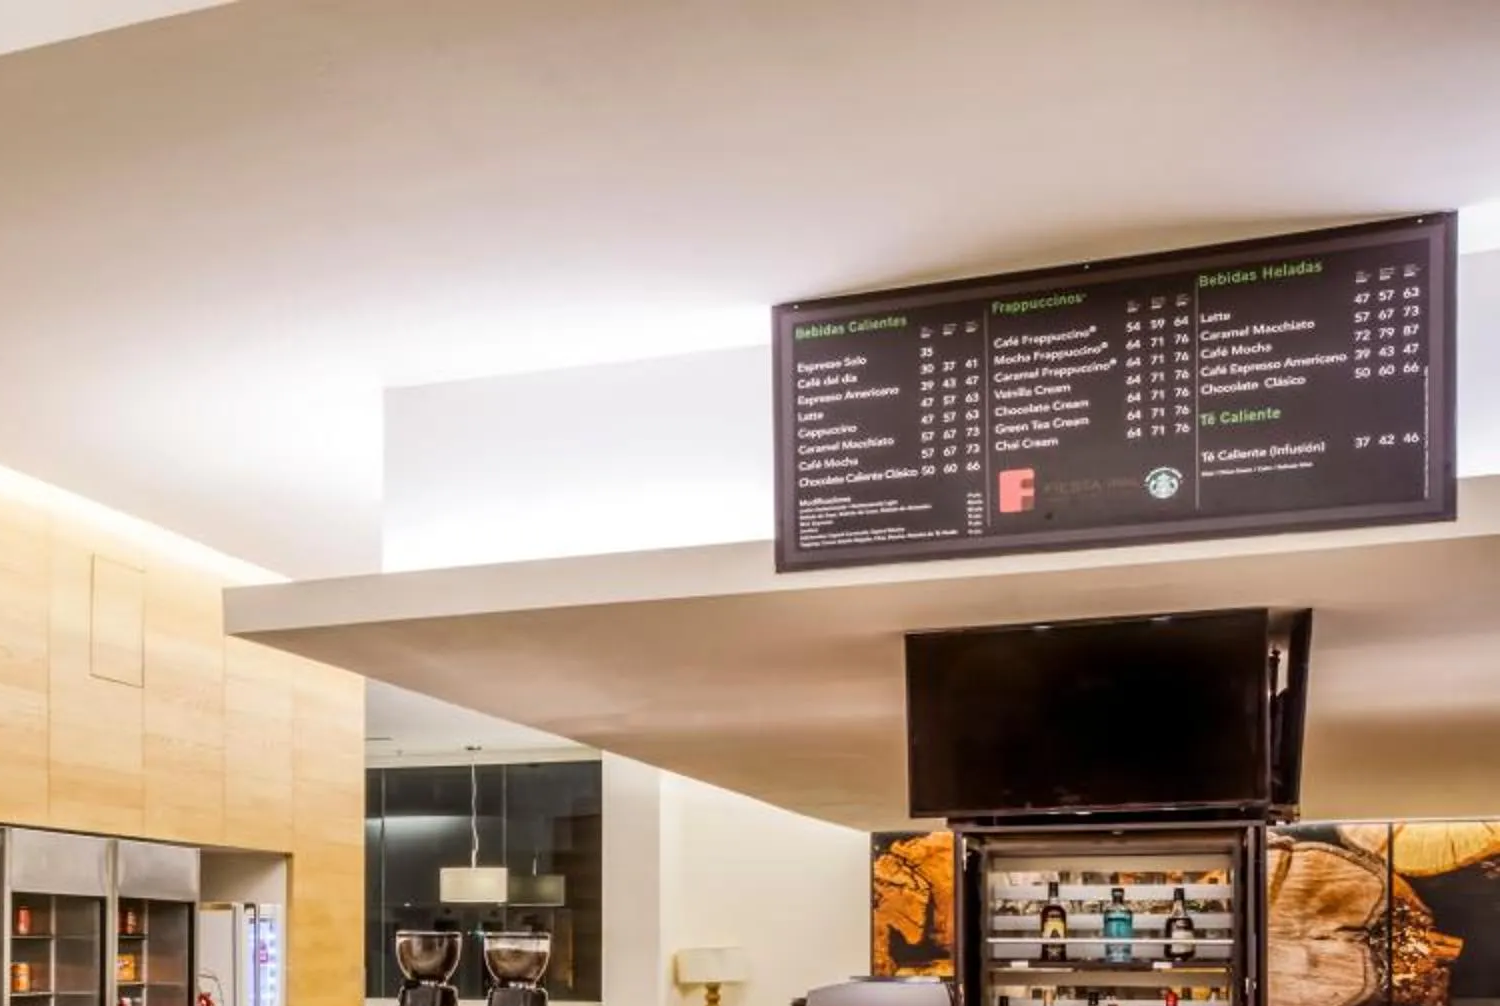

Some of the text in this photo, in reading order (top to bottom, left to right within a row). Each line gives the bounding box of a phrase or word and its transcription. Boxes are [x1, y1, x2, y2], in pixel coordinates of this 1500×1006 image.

[1199, 261, 1323, 288] Bebidas Heladas
[1201, 312, 1231, 323] Latte
[1354, 293, 1370, 303] 47
[1378, 290, 1394, 302] 57
[795, 323, 844, 339] Bebidas
[849, 316, 907, 333] Calientes
[1126, 321, 1140, 332] 54
[1173, 316, 1188, 327] 64
[1200, 306, 1420, 341] Caramel Macchiato 57 67 73
[994, 354, 1030, 365] Mocha
[1126, 340, 1140, 350] 64
[1151, 337, 1164, 348] 71
[1175, 334, 1189, 345] 76
[1232, 343, 1273, 355] Mocha
[1354, 330, 1370, 341] 72
[1378, 327, 1394, 339] 79
[994, 369, 1039, 382] Caramel
[1126, 357, 1141, 367] 64
[1151, 354, 1164, 365] 71
[1175, 352, 1189, 362] 76
[1201, 364, 1227, 377] Café
[1284, 352, 1347, 369] Americano
[1378, 346, 1394, 357] 43
[1403, 344, 1419, 354] 47
[844, 386, 899, 400] Americano
[1034, 383, 1071, 396] Cream
[1126, 374, 1141, 384] 64
[1151, 372, 1164, 382] 71
[1175, 369, 1189, 380] 76
[1201, 381, 1258, 395] Chocolate
[1354, 367, 1371, 379] 50
[1378, 365, 1394, 377] 60
[1403, 363, 1419, 374] 66
[995, 387, 1190, 416] Chocolate Cream 64 71 76
[1220, 406, 1281, 424] Caliente
[943, 412, 956, 422] 57
[965, 410, 979, 420] 63
[995, 405, 1190, 434] Green Tea Cream 64 71 76
[1022, 438, 1058, 448] Cream
[1127, 427, 1142, 439] 64
[1151, 425, 1165, 436] 71
[1175, 423, 1190, 433] 76
[1218, 447, 1266, 461] Caliente
[1355, 437, 1370, 448] 37
[1403, 432, 1420, 443] 46
[921, 448, 934, 459] 57
